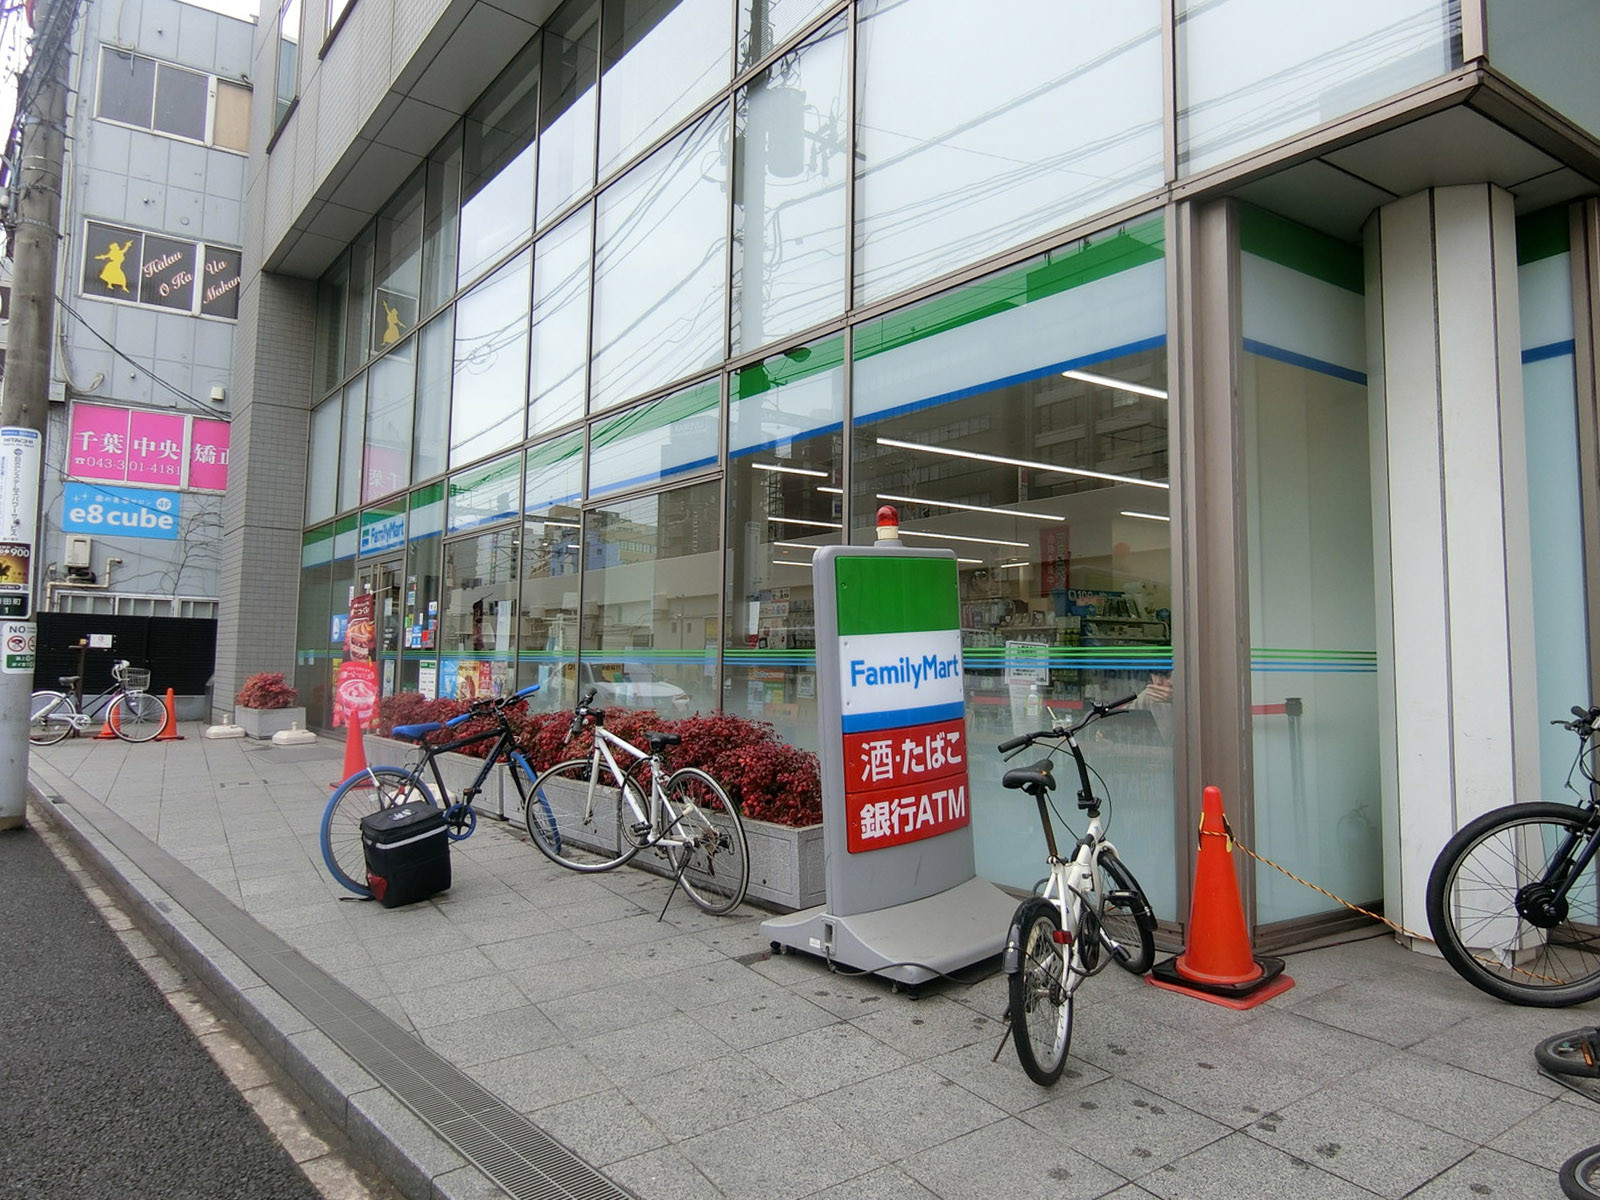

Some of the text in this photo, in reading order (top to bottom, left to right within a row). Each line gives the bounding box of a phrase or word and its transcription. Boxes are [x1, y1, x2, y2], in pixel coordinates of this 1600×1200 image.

[371, 520, 405, 543] FamilyMart
[9, 625, 26, 634] NO
[850, 653, 960, 690] FamilyMart
[859, 730, 963, 783] 酒・たばこ
[858, 784, 966, 841] 銀行ATM
